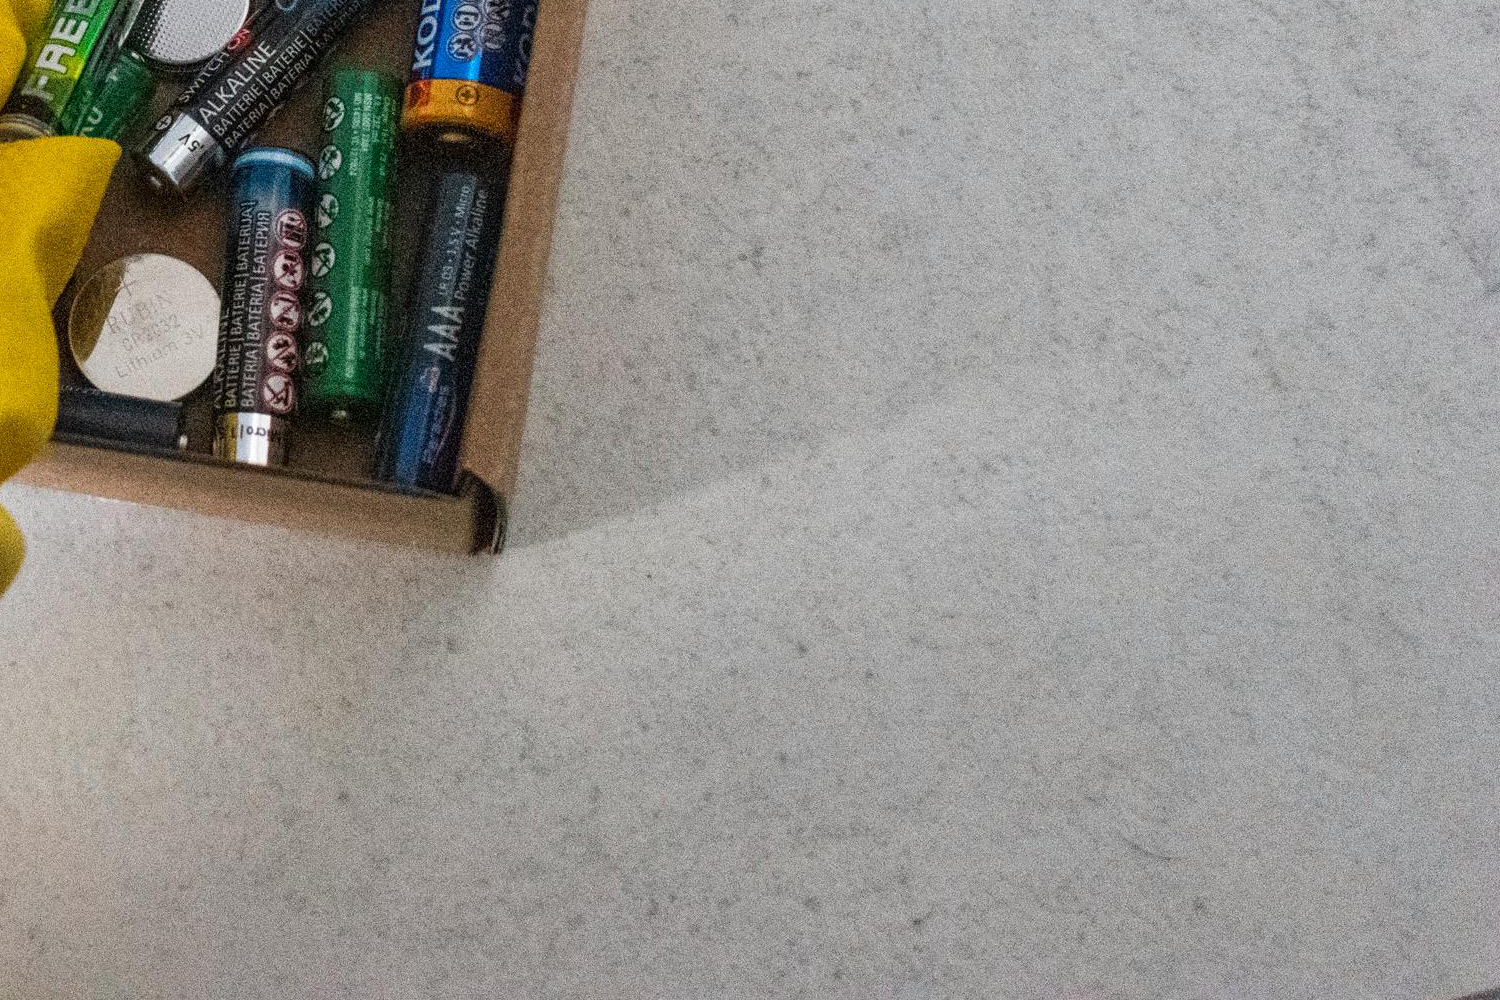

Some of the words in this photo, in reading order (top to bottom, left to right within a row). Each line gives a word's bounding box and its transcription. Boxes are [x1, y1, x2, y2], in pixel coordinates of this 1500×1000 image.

[195, 37, 278, 129] ALKALINE
[210, 81, 264, 140] BATTERIE
[258, 33, 308, 86] BATERIE
[221, 97, 272, 153] BATERIA
[453, 184, 470, 219] Micro
[462, 186, 490, 250] Alkaline
[234, 206, 255, 271] BATERIJA
[453, 249, 477, 300] Power
[119, 312, 182, 353] CR2032
[229, 277, 248, 336] BATERIE
[242, 280, 265, 340] BATÉRIA
[420, 299, 465, 362] AAA
[113, 340, 180, 378] Lithium
[179, 322, 207, 347] 3V
[222, 343, 242, 409] BATTERIE
[239, 347, 260, 409] BATERIA
